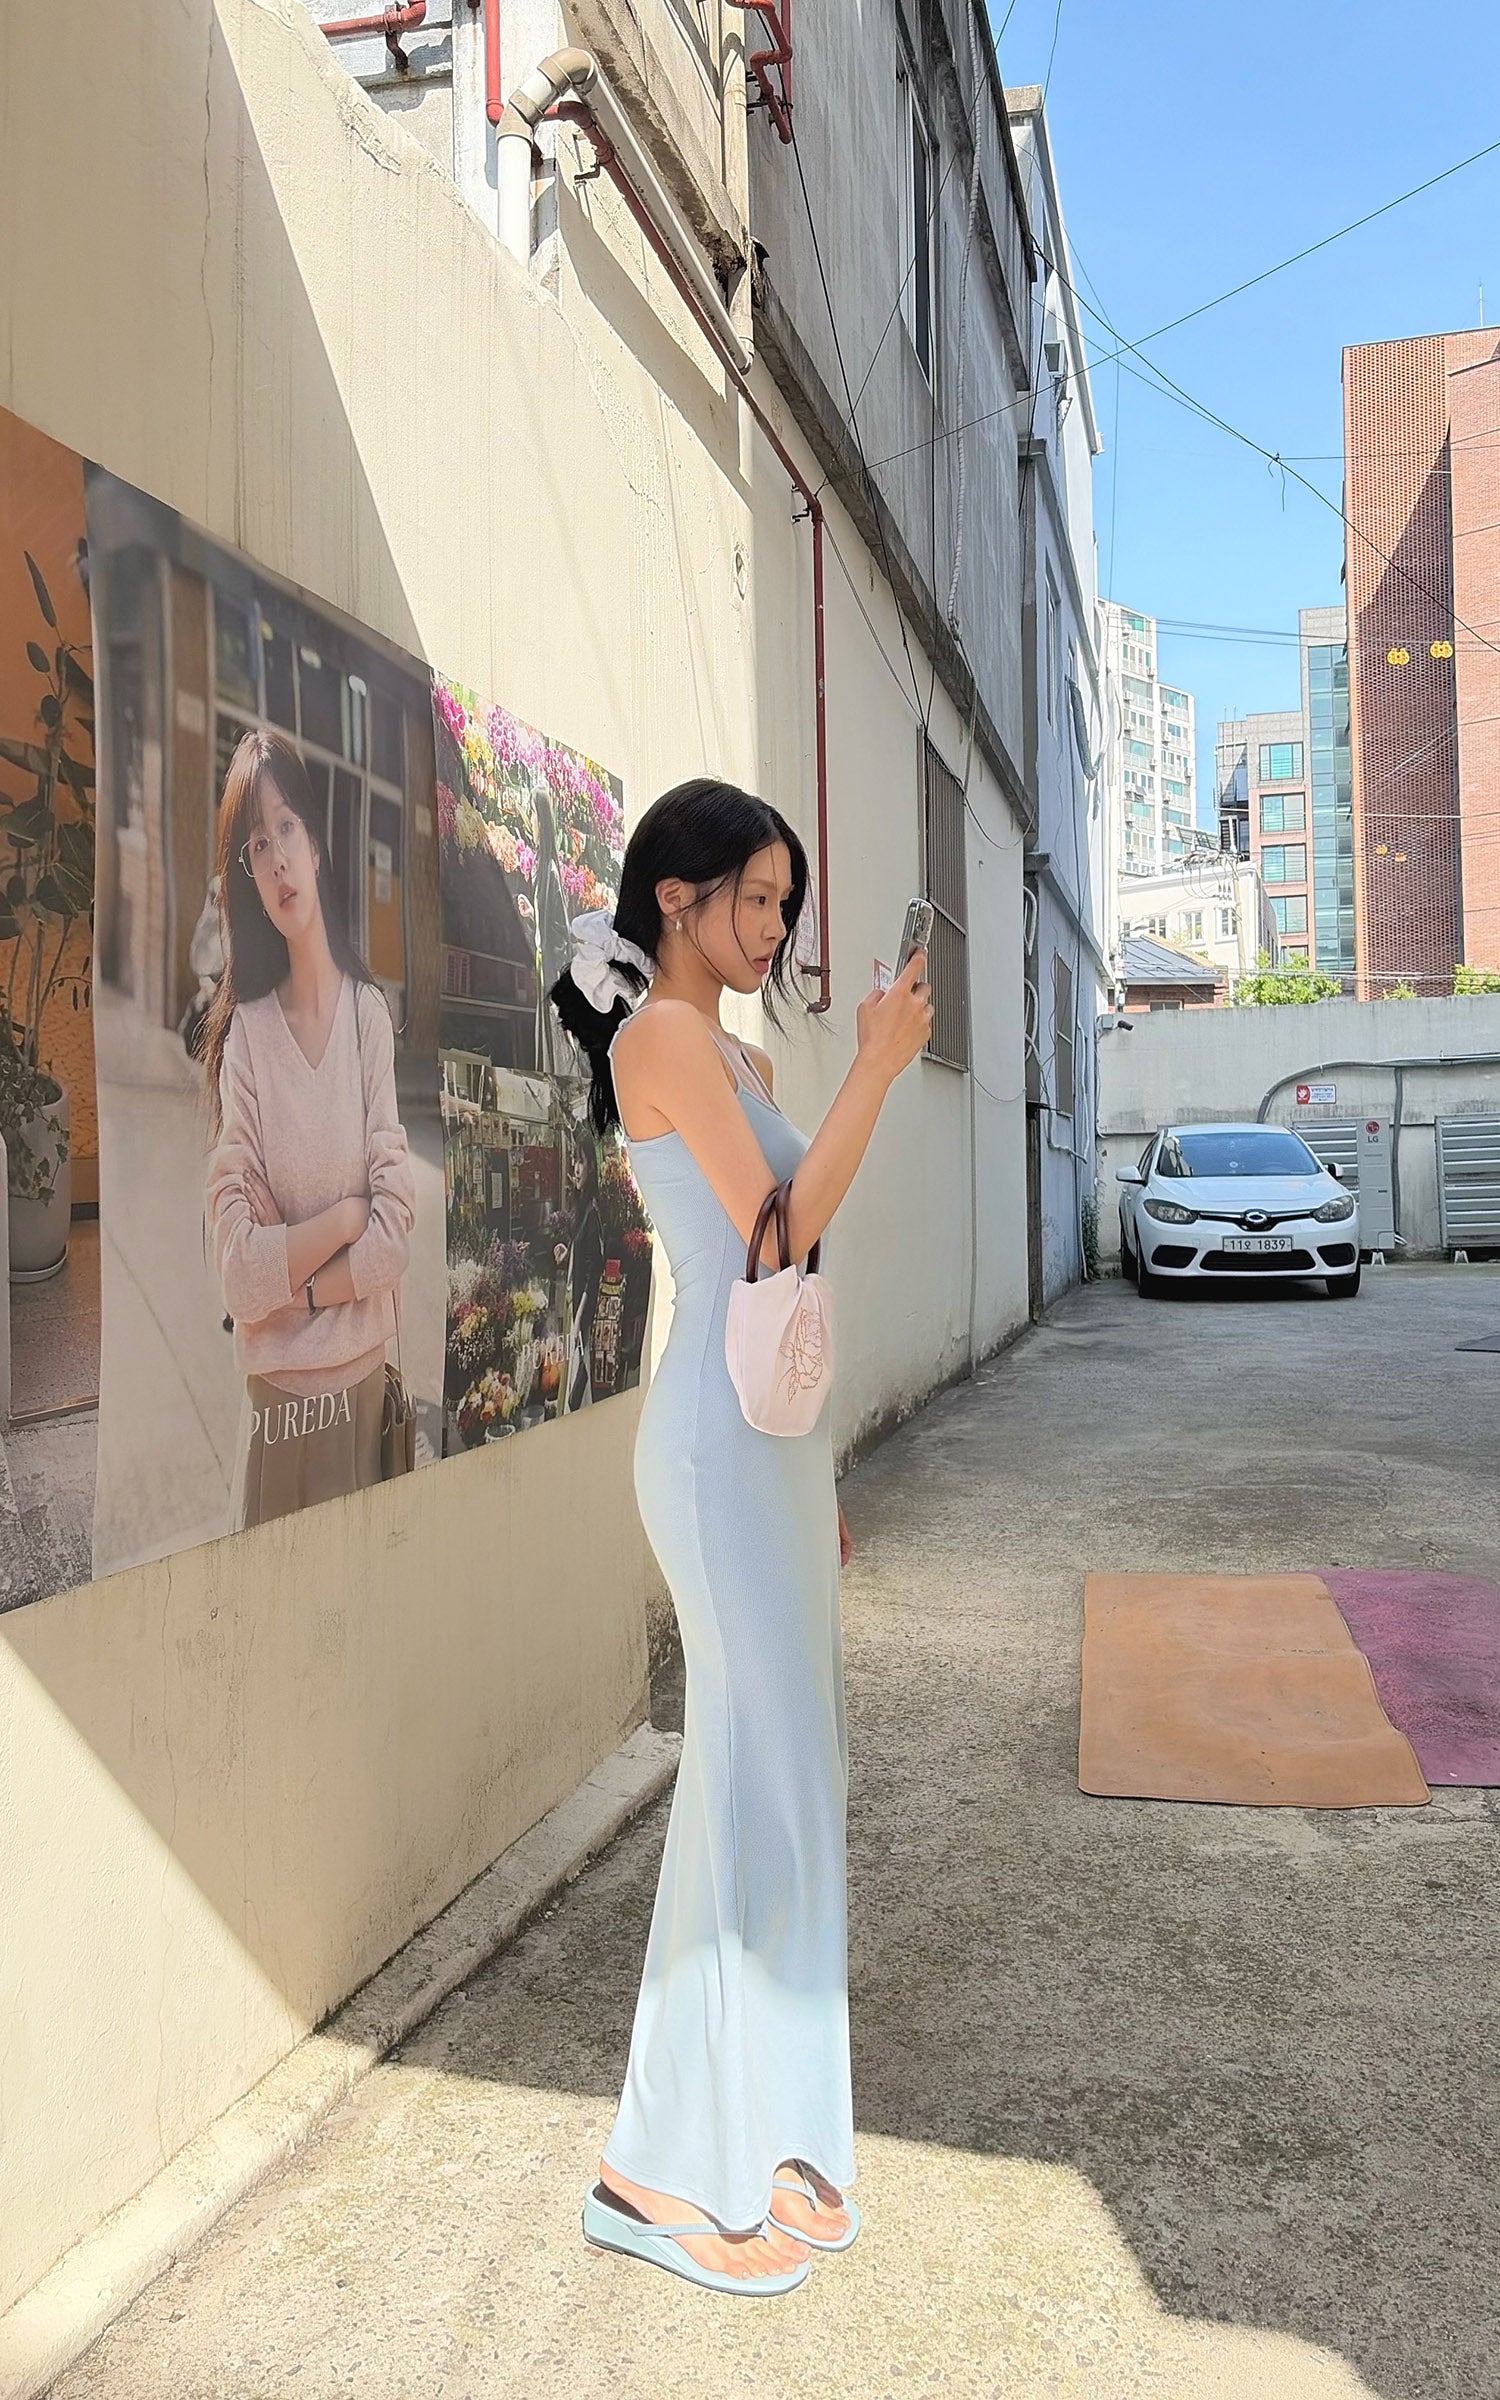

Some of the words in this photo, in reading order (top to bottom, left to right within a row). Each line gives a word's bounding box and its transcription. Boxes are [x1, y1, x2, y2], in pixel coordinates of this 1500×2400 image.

[1367, 1135, 1379, 1143] LG
[1230, 1240, 1252, 1250] 11오
[1258, 1239, 1286, 1250] 1839
[246, 1388, 351, 1449] PUREDA
